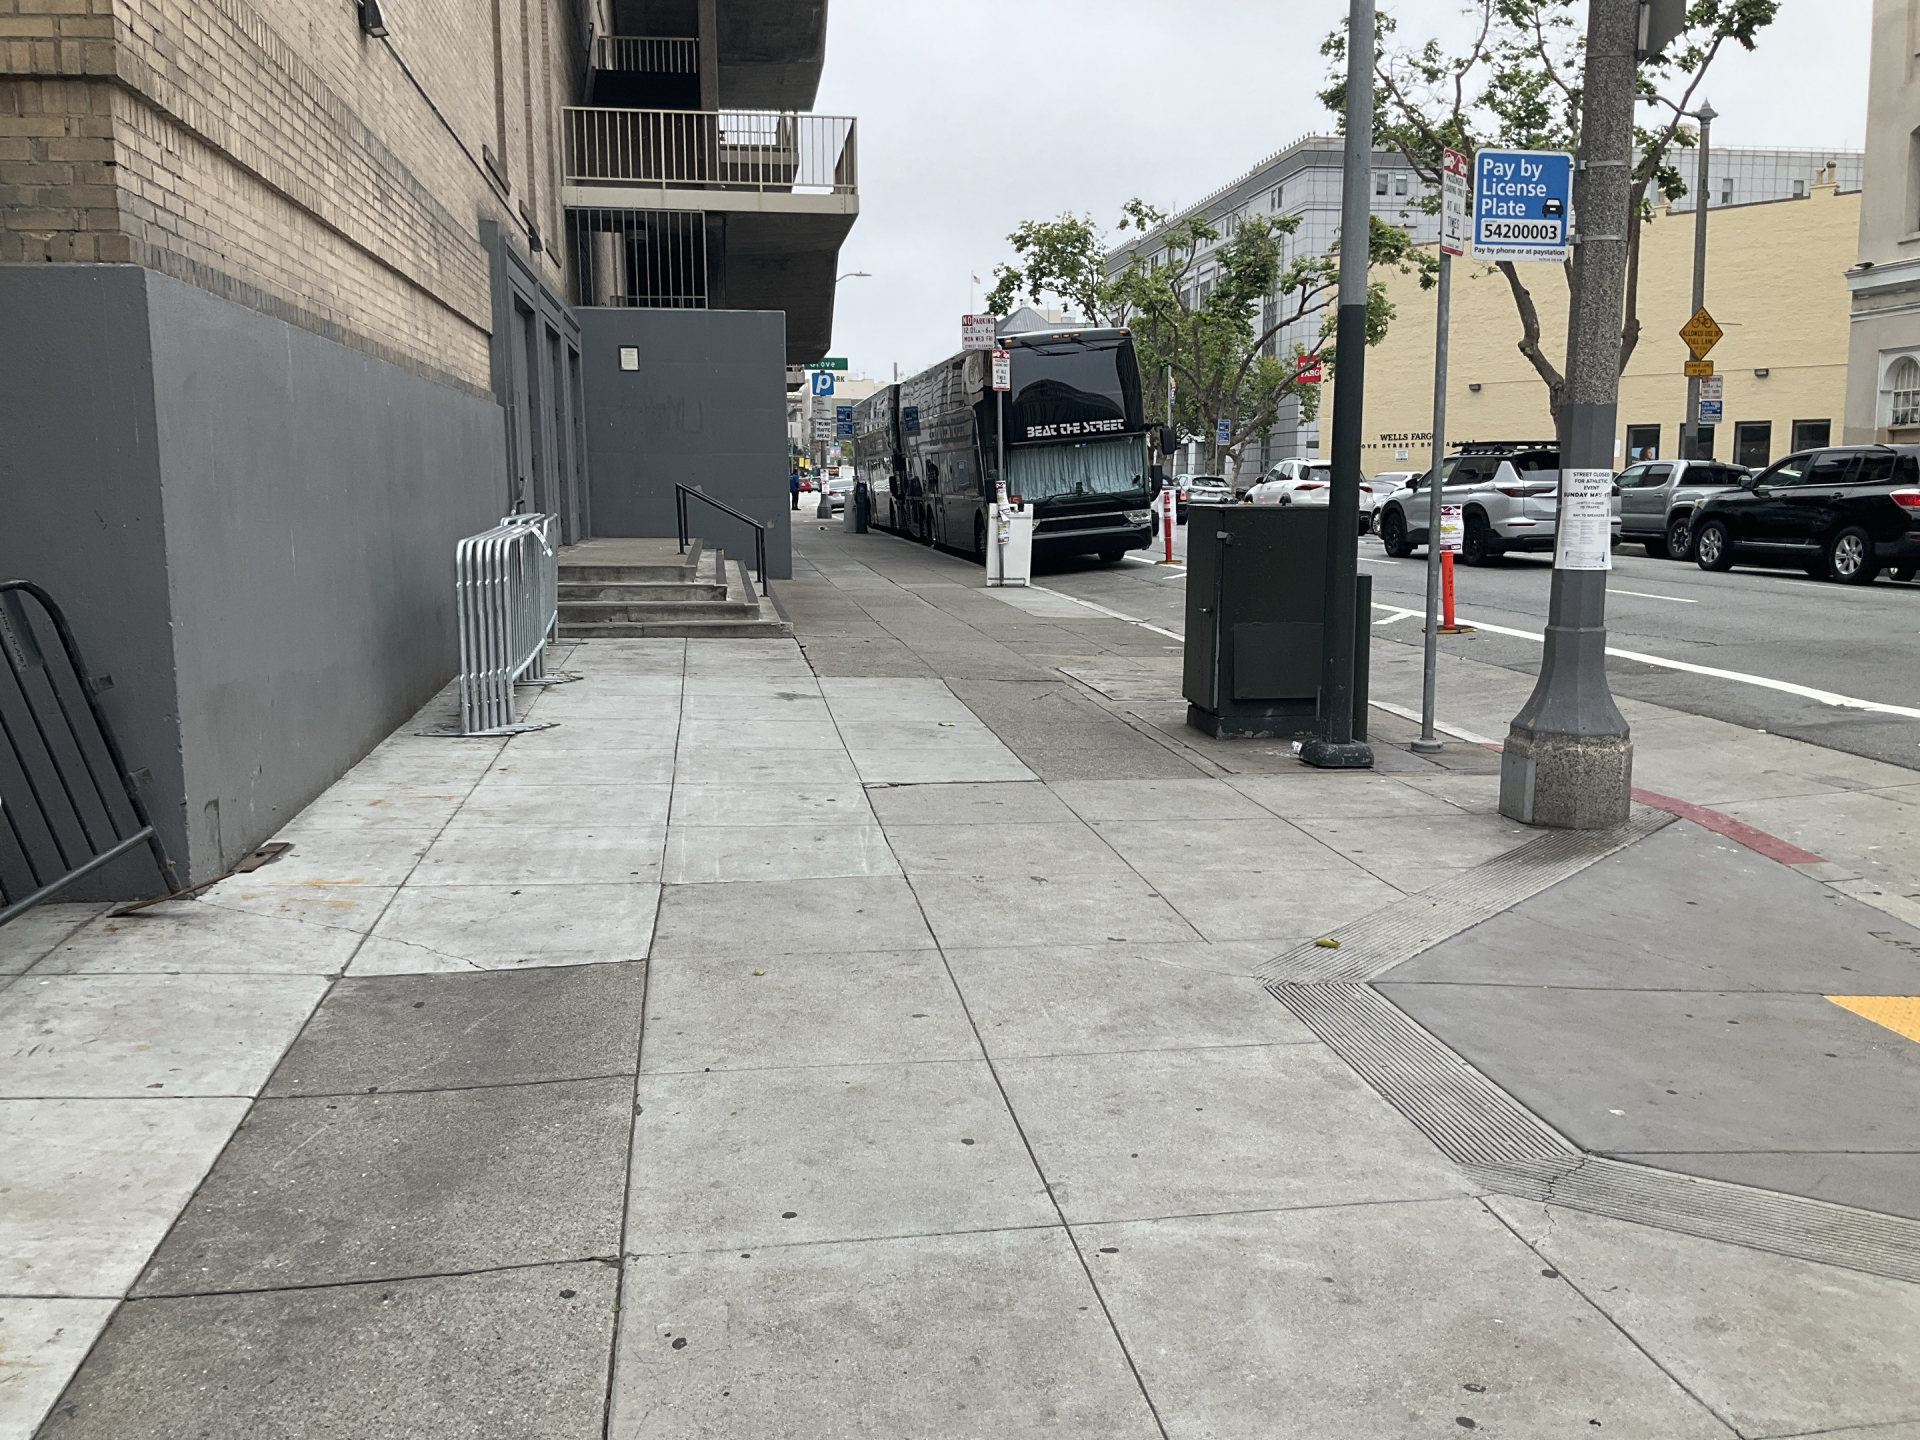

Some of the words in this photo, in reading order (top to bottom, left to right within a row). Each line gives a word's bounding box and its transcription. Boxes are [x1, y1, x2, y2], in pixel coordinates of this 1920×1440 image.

[1482, 158, 1515, 179] Pay
[1520, 158, 1543, 182] by
[1446, 173, 1464, 186] PASSENGER
[1444, 184, 1456, 195] LOADING
[1482, 178, 1546, 197] License
[1447, 200, 1452, 211] AT
[1482, 198, 1526, 216] Plate
[1448, 216, 1460, 229] TIMES
[1484, 223, 1557, 240] 54200003
[1474, 246, 1486, 255] Pay
[1496, 248, 1516, 256] phone
[963, 316, 972, 325] NO
[1301, 369, 1322, 377] ARG
[1027, 424, 1057, 438] BEAT
[1060, 422, 1080, 434] THE
[1083, 419, 1124, 433] STREET
